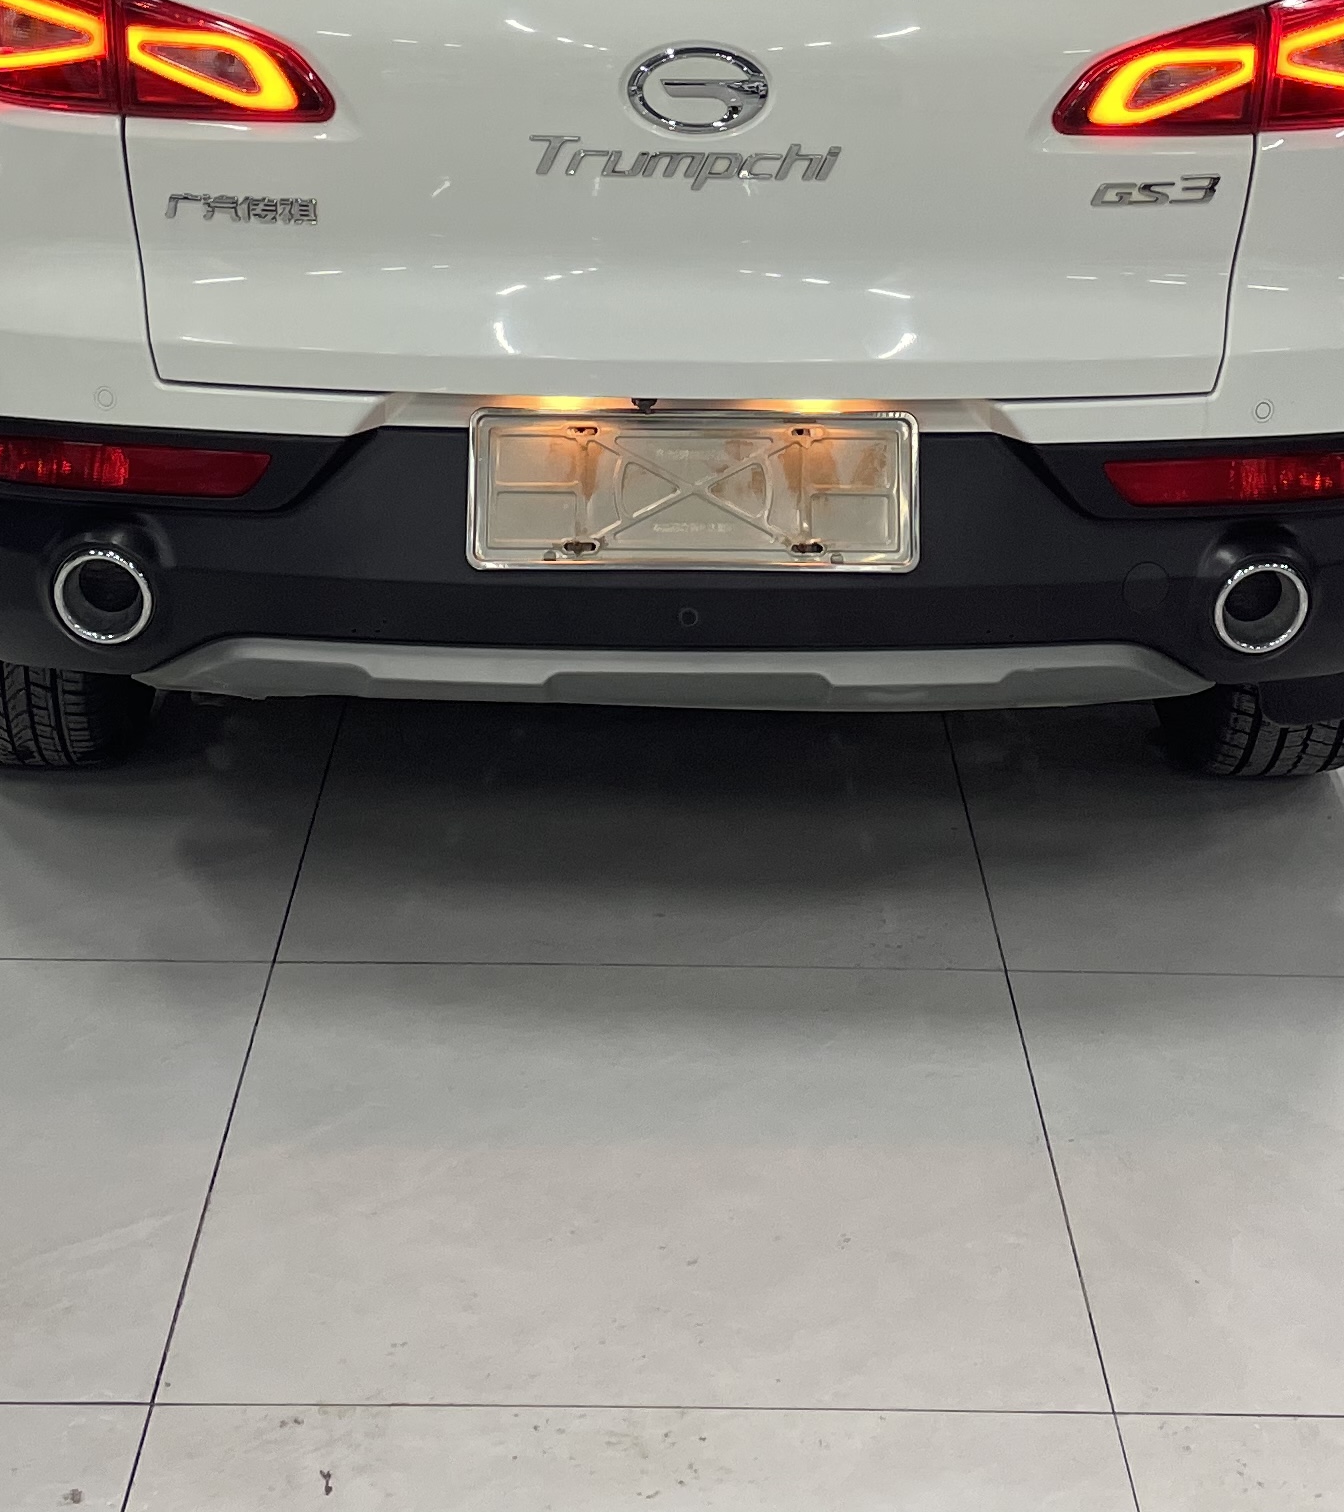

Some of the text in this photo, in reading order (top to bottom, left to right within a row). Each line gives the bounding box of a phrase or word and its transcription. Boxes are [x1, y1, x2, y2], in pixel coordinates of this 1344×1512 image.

[529, 135, 842, 191] Trumpchi
[1090, 173, 1222, 207] GS3
[164, 193, 318, 226] 广汽传祺
